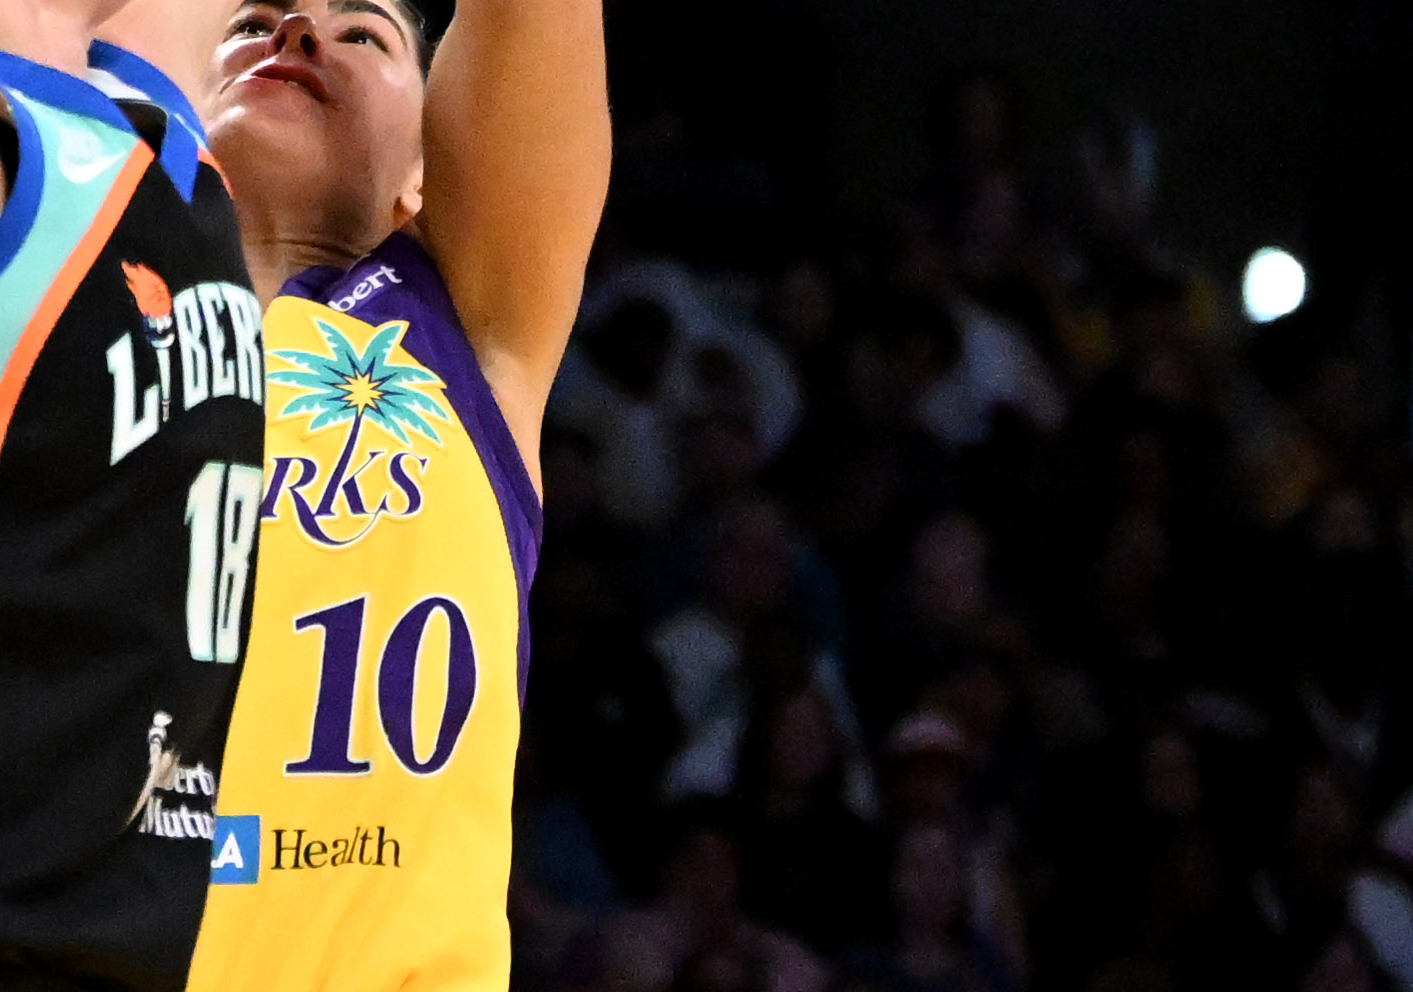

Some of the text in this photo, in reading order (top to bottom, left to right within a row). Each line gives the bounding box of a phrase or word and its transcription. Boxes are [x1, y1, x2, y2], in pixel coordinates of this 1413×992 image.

[183, 460, 264, 664] 18
[283, 592, 478, 778] 10
[270, 824, 402, 871] Health
